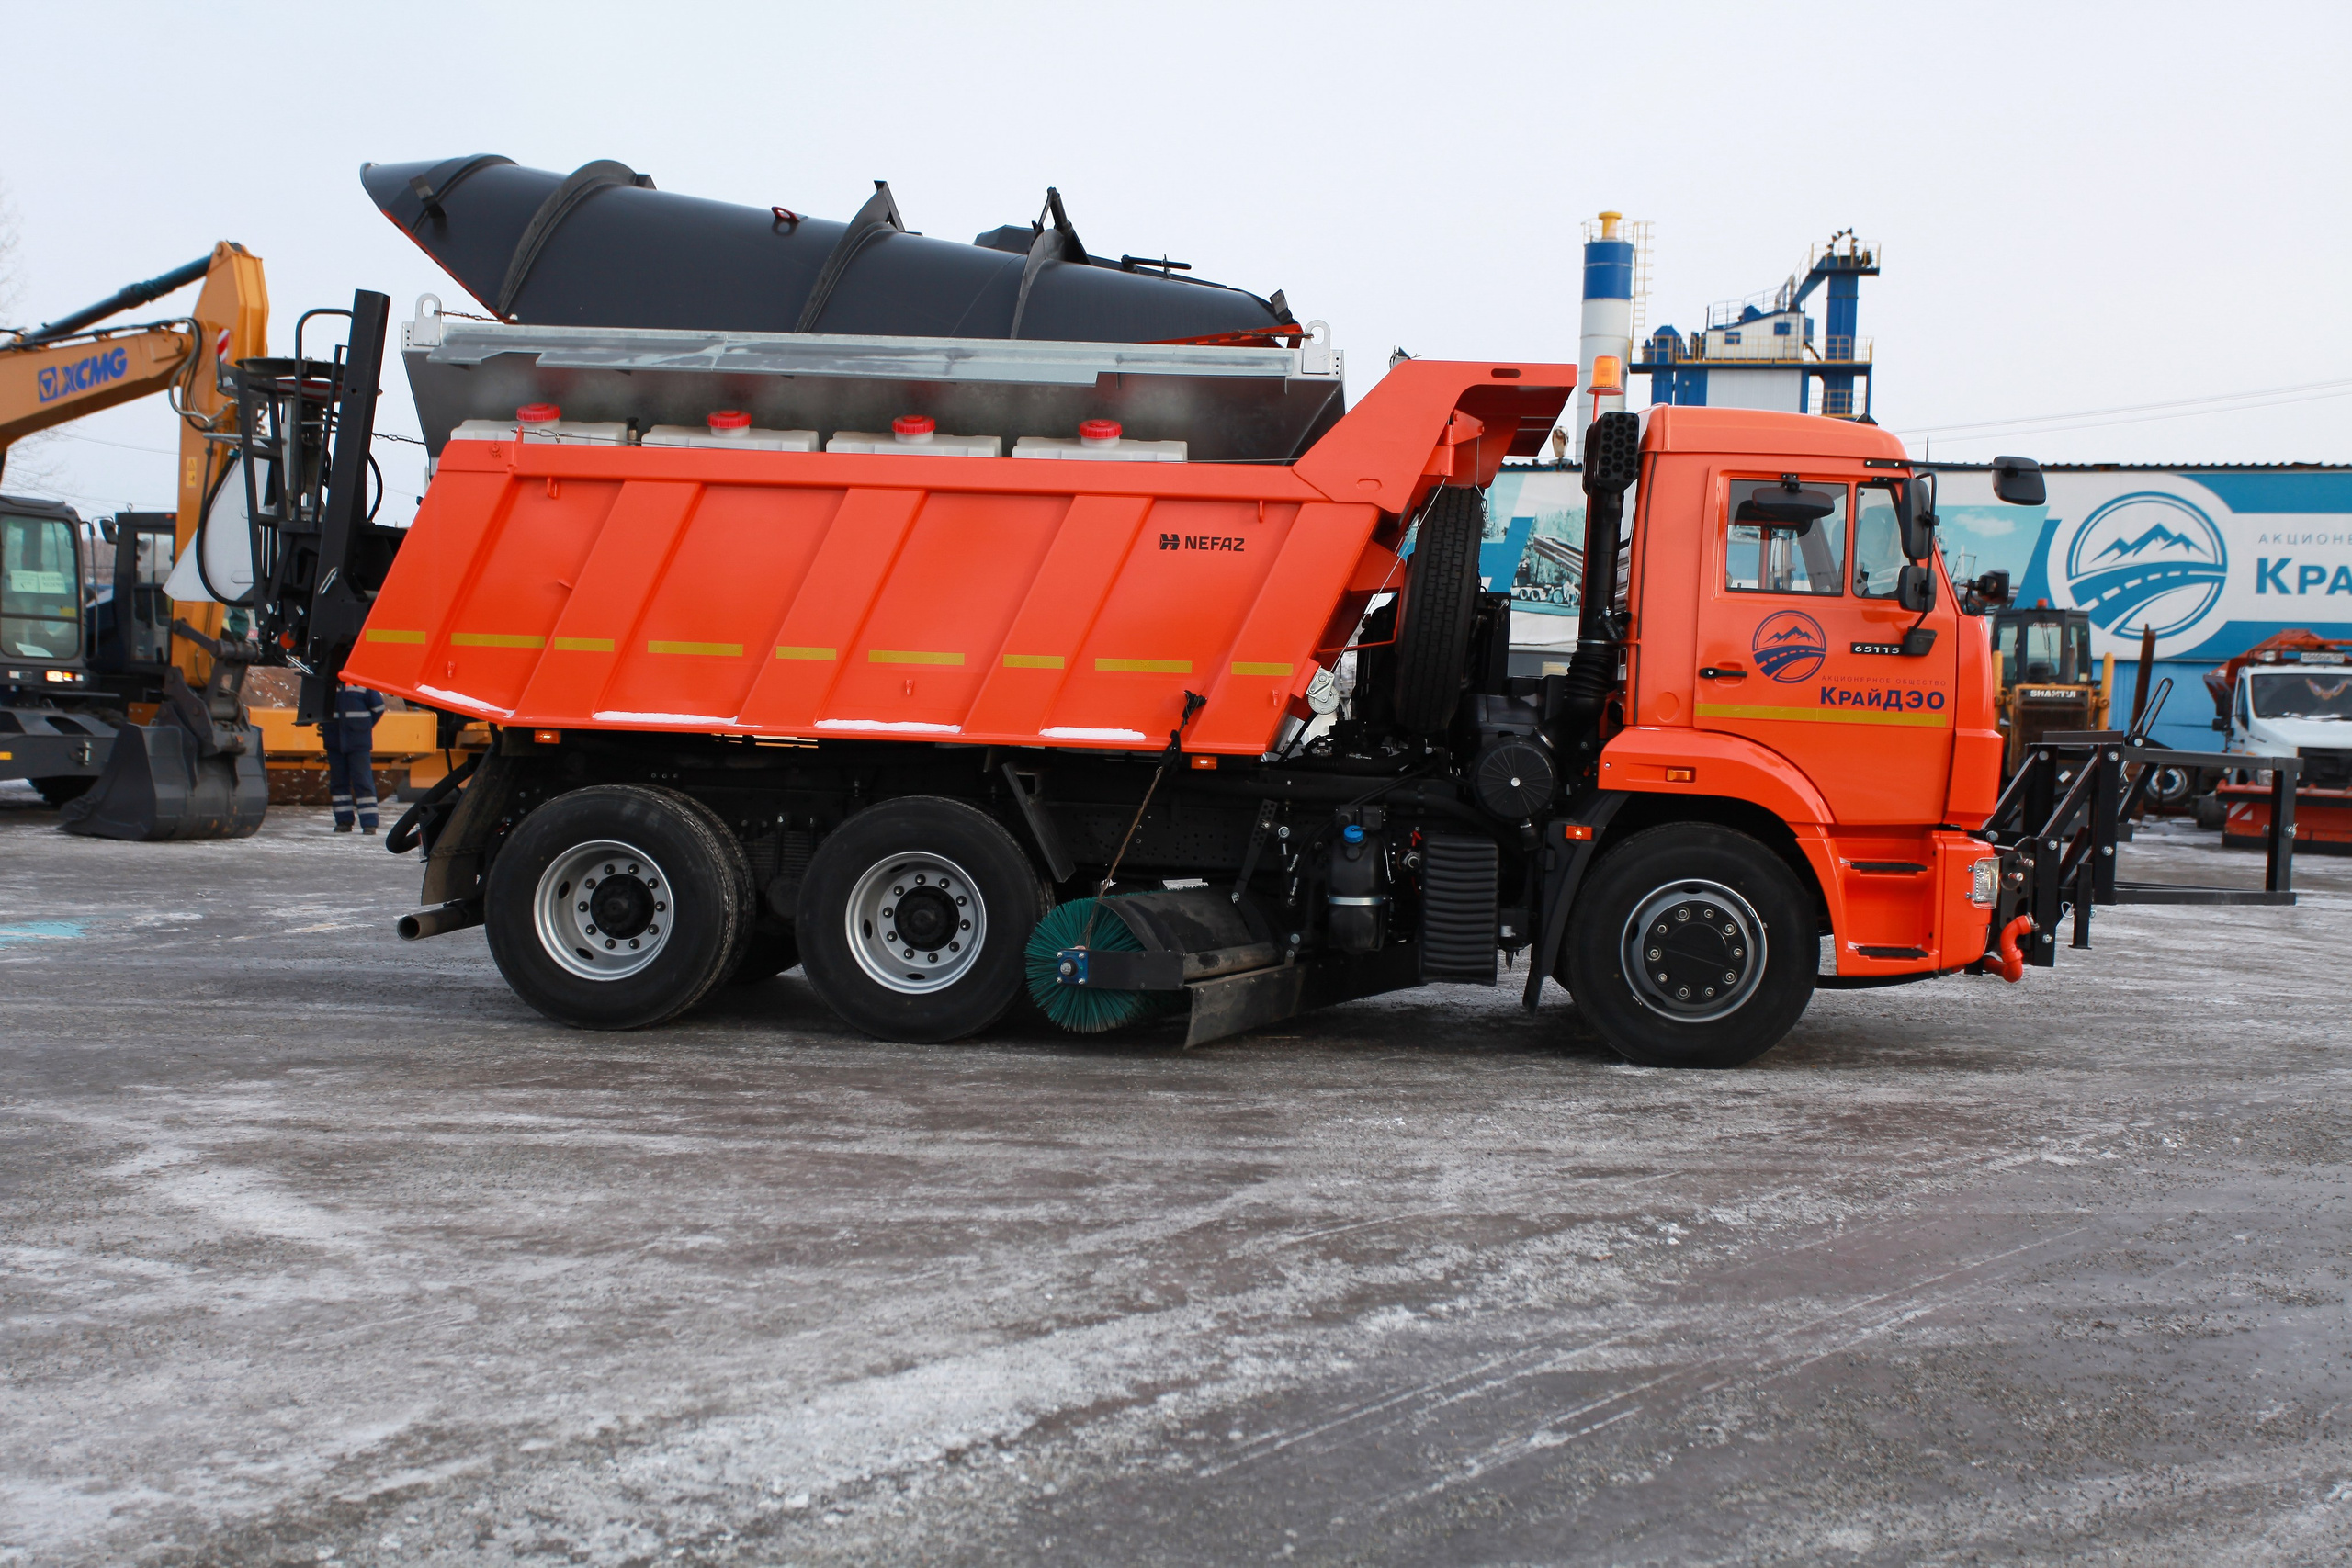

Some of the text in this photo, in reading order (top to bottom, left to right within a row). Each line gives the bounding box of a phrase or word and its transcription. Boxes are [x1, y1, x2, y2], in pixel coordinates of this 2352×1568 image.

[61, 346, 128, 396] XCMG
[1184, 536, 1245, 552] NEFAZ
[1854, 645, 1901, 654] 65115
[1821, 675, 1947, 686] АКЦИОНЕРНОЕ ОБЩЕСТВО
